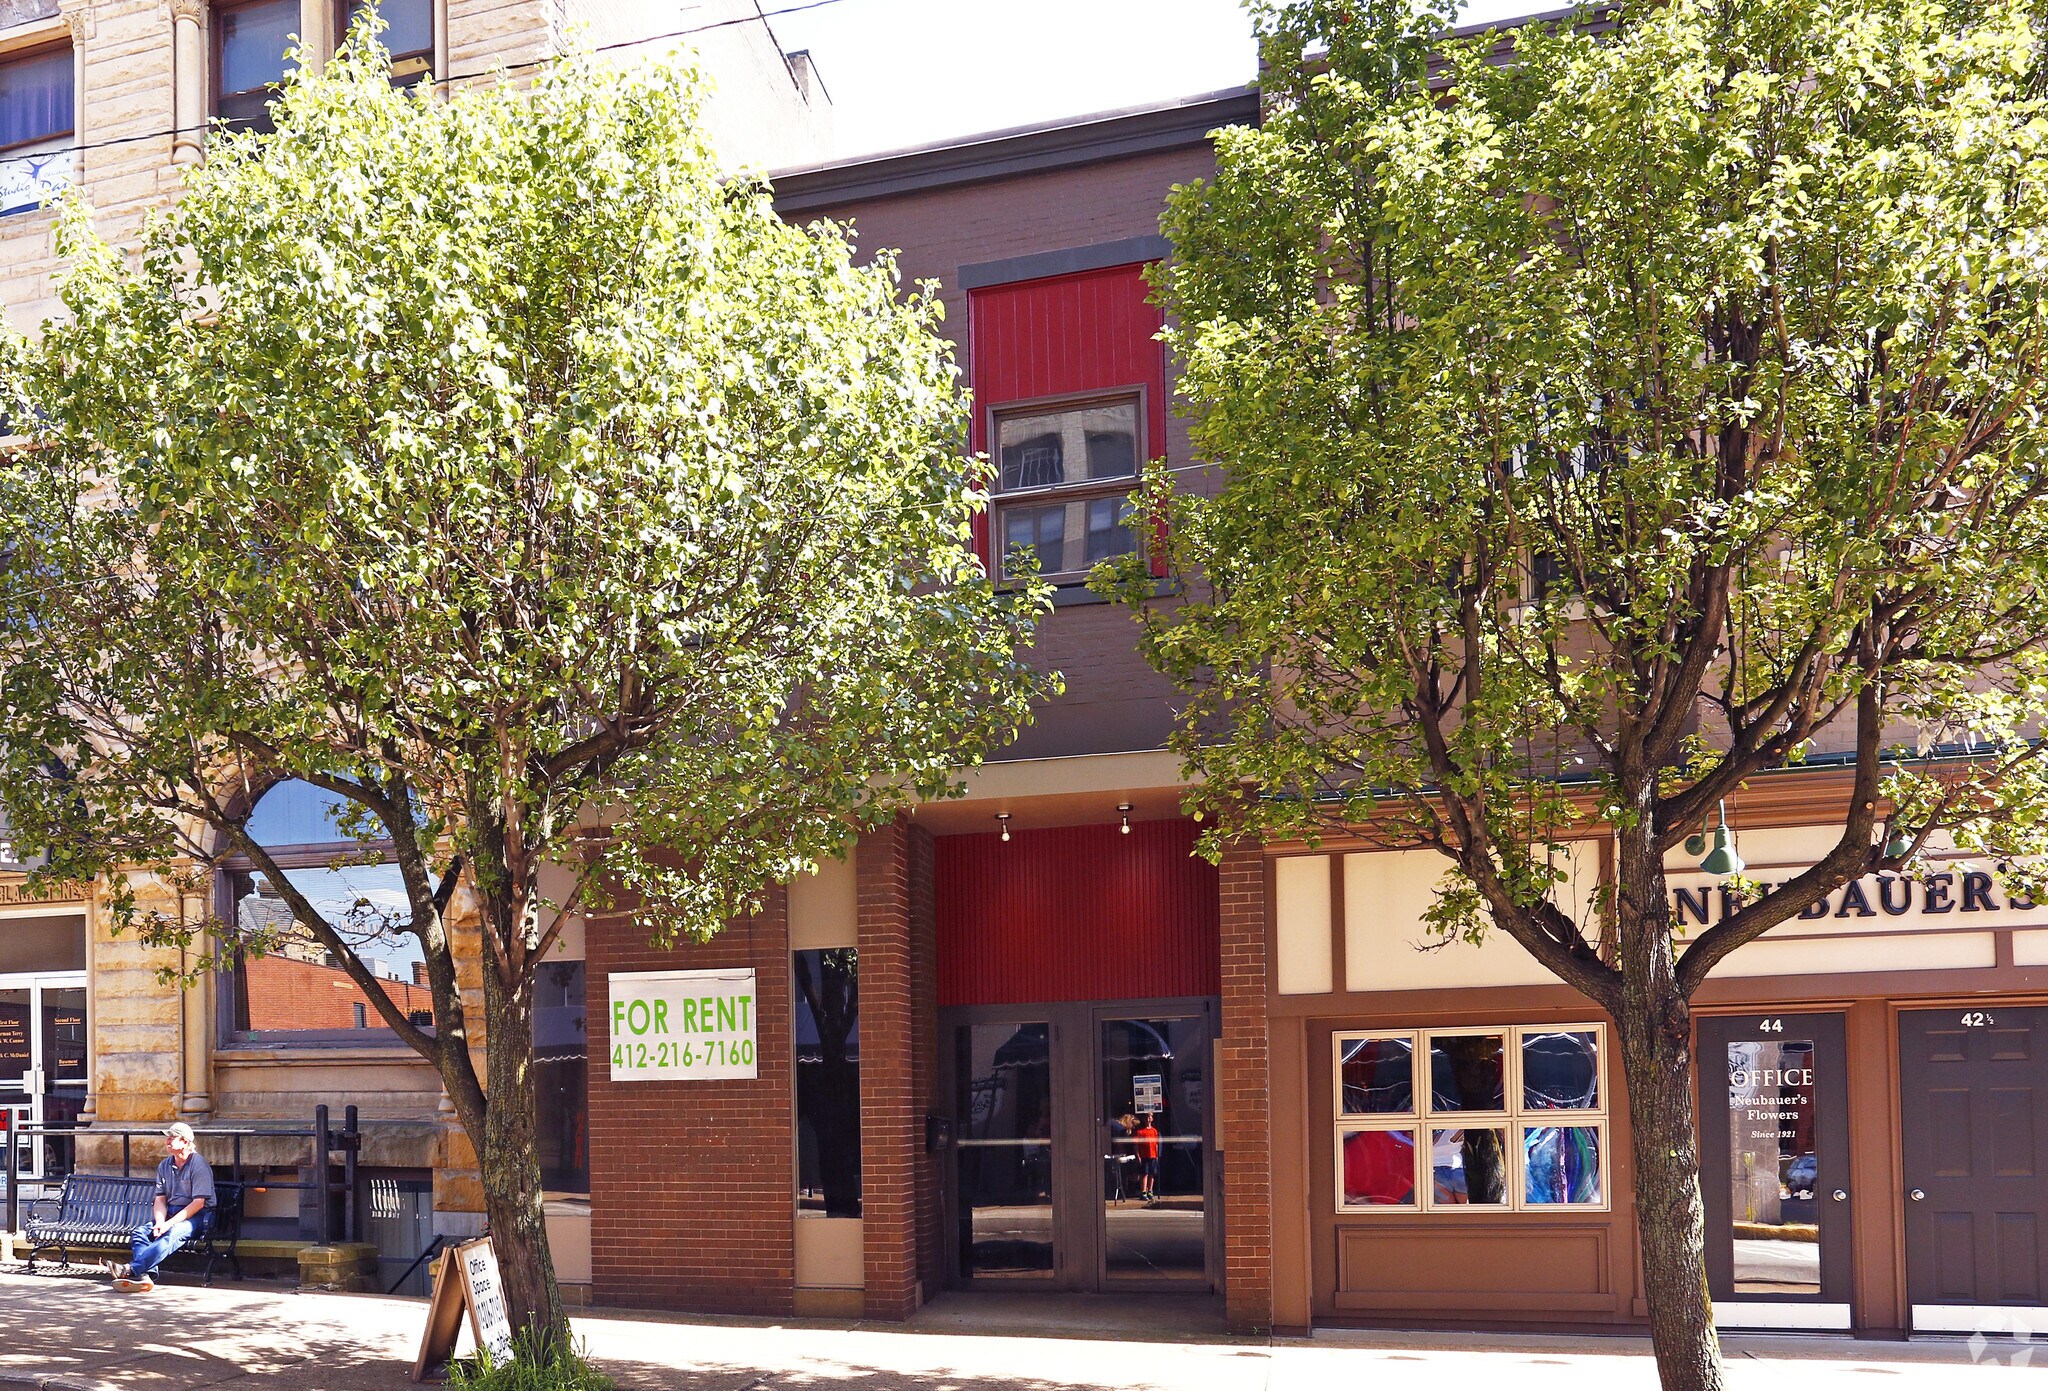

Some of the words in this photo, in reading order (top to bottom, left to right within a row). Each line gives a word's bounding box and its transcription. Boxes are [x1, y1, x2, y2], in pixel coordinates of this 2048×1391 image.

[613, 999, 669, 1036] FOR
[683, 995, 752, 1034] RENT
[1759, 1019, 1783, 1033] 44
[612, 1039, 754, 1069] 412-216-7160
[1731, 1069, 1813, 1088] OFFICE
[1735, 1094, 1808, 1105] Neubauer's
[1747, 1109, 1799, 1120] Flowers
[1751, 1130, 1775, 1138] Since
[1777, 1130, 1796, 1138] 1921
[469, 1258, 487, 1276] Office
[472, 1277, 491, 1298] Space
